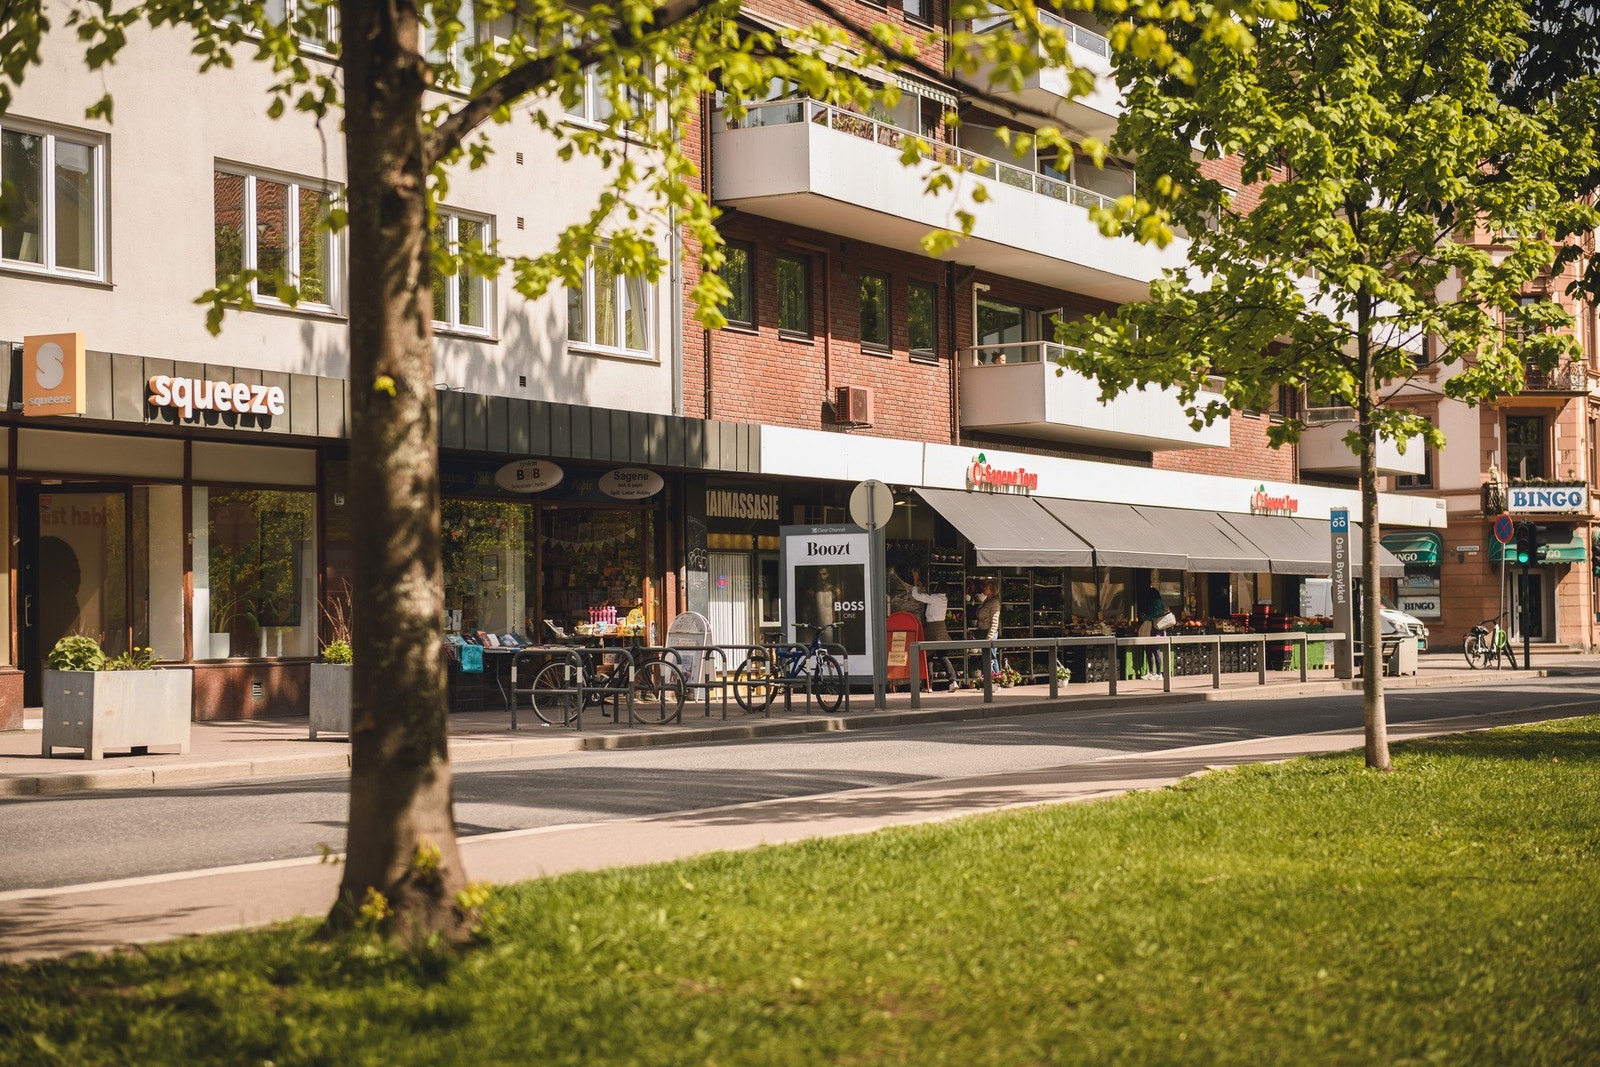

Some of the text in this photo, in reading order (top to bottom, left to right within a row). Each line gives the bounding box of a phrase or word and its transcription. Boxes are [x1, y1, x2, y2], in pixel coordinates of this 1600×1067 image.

[29, 395, 72, 408] squeeze
[149, 375, 285, 418] squeeze
[613, 471, 649, 483] Sagene
[985, 463, 1038, 491] Sagene Torg
[1513, 491, 1583, 507] BINGO
[807, 541, 851, 556] Boozt
[1393, 553, 1418, 562] INGO
[1334, 537, 1346, 604] Oslo Bysykkel
[834, 600, 865, 611] BOSS
[1404, 602, 1435, 611] BINGO
